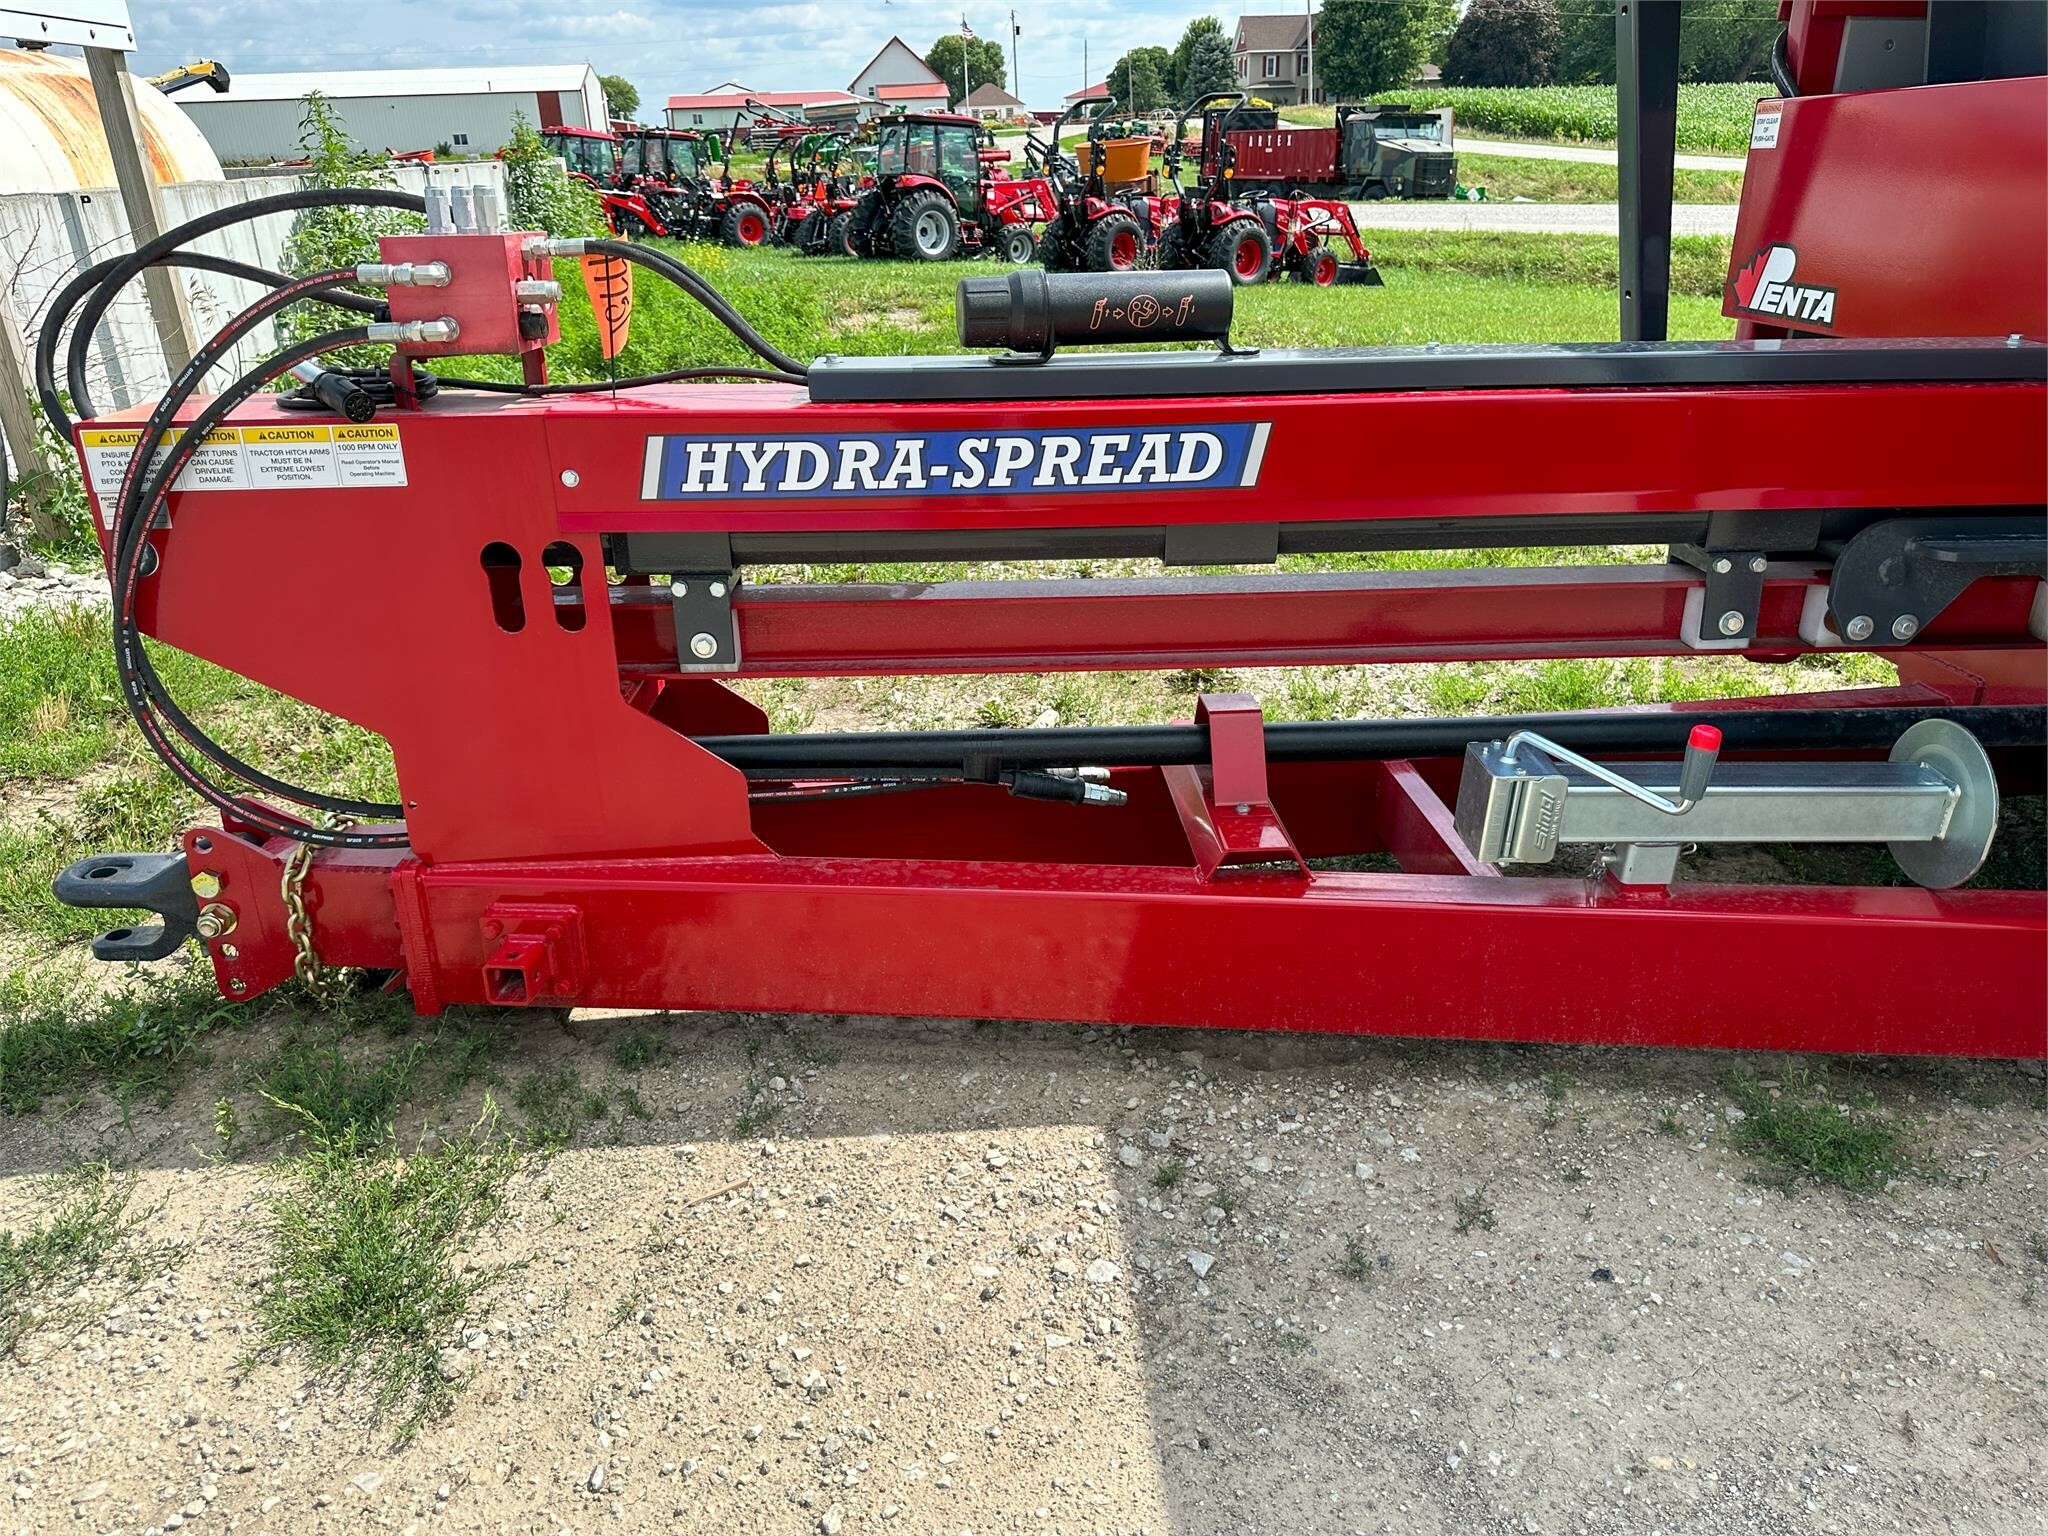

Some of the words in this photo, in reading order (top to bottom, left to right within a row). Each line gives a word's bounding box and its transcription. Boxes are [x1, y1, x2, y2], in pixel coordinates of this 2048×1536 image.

[1249, 134, 1292, 147] ARTEX
[1749, 246, 1836, 324] PENTA
[268, 431, 315, 440] CAUTION
[347, 429, 393, 438] CAUTION
[357, 443, 376, 451] RPM
[681, 431, 1225, 493] HYDRA-SPREAD
[312, 833, 334, 841] GRYPHON
